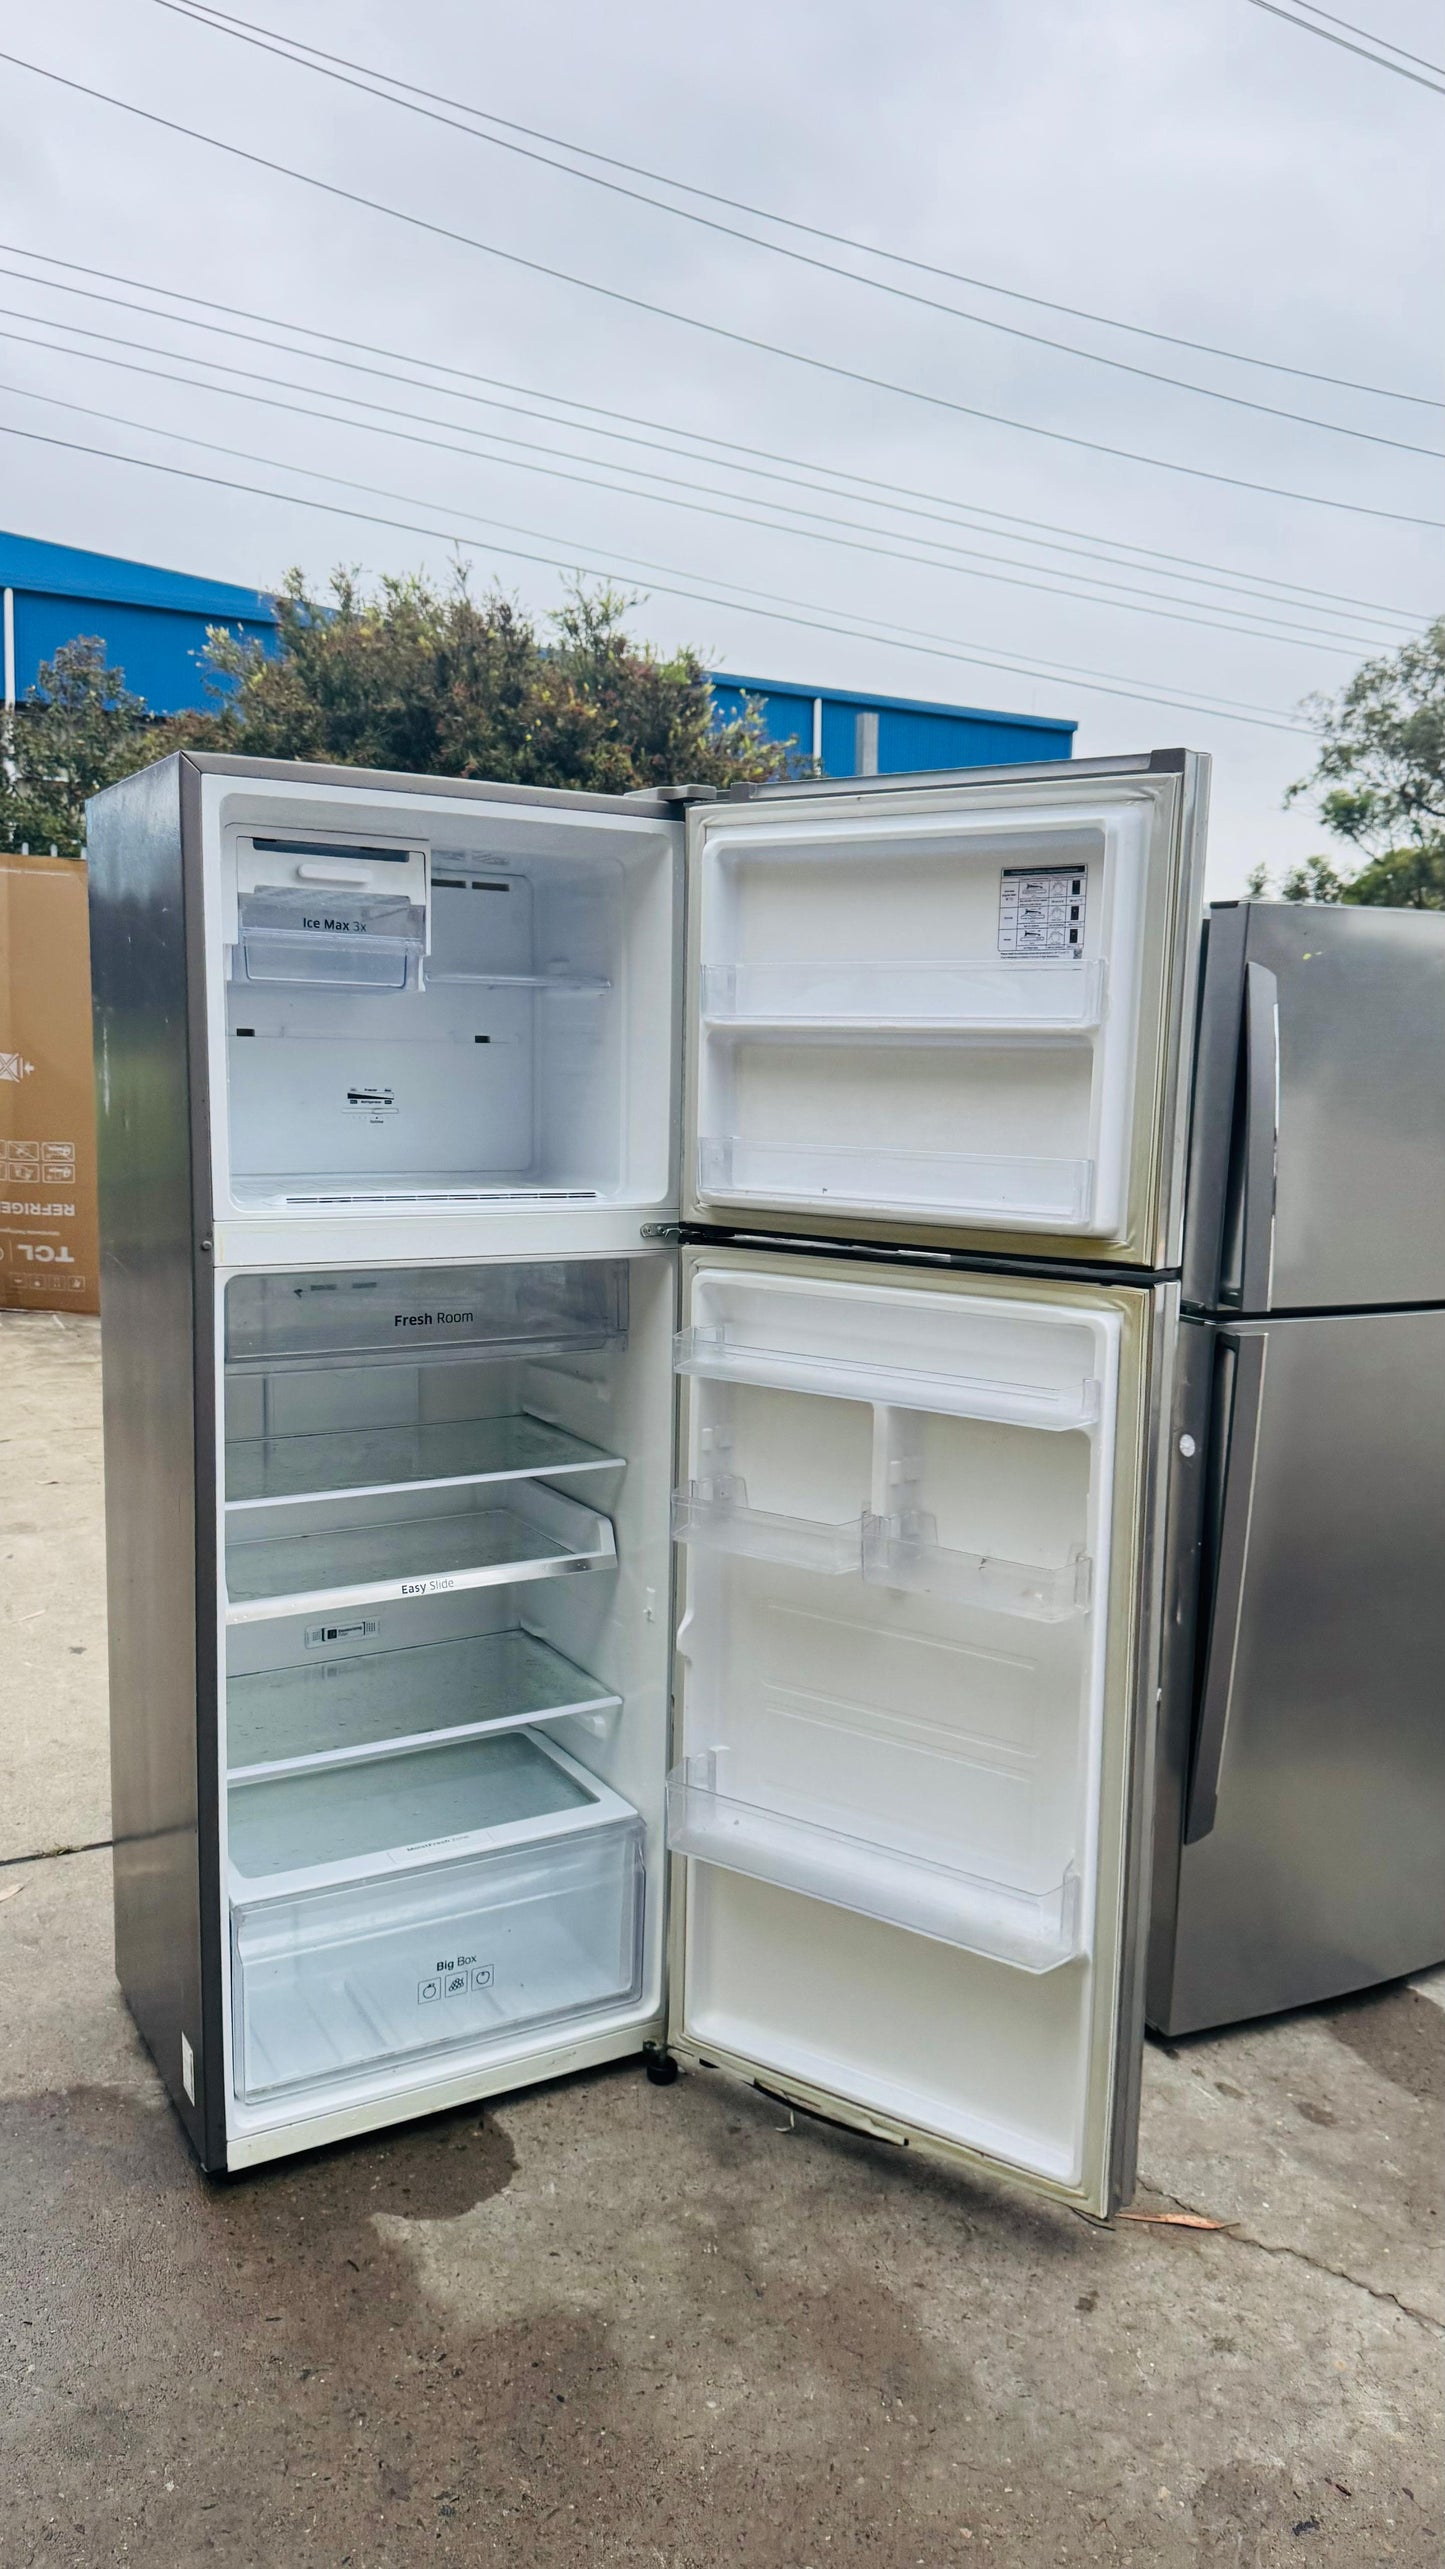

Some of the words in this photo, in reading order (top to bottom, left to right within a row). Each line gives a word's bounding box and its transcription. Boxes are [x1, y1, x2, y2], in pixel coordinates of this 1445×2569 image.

[303, 917, 320, 929] Ice
[324, 919, 349, 931] Max
[352, 921, 367, 932] 3x
[17, 1244, 75, 1263] TCL
[394, 1313, 433, 1327] Fresh
[437, 1312, 474, 1324] Room
[401, 1583, 427, 1595] Easy
[429, 1579, 455, 1591] Slide
[436, 1960, 455, 1971] Big
[457, 1955, 477, 1967] Box
